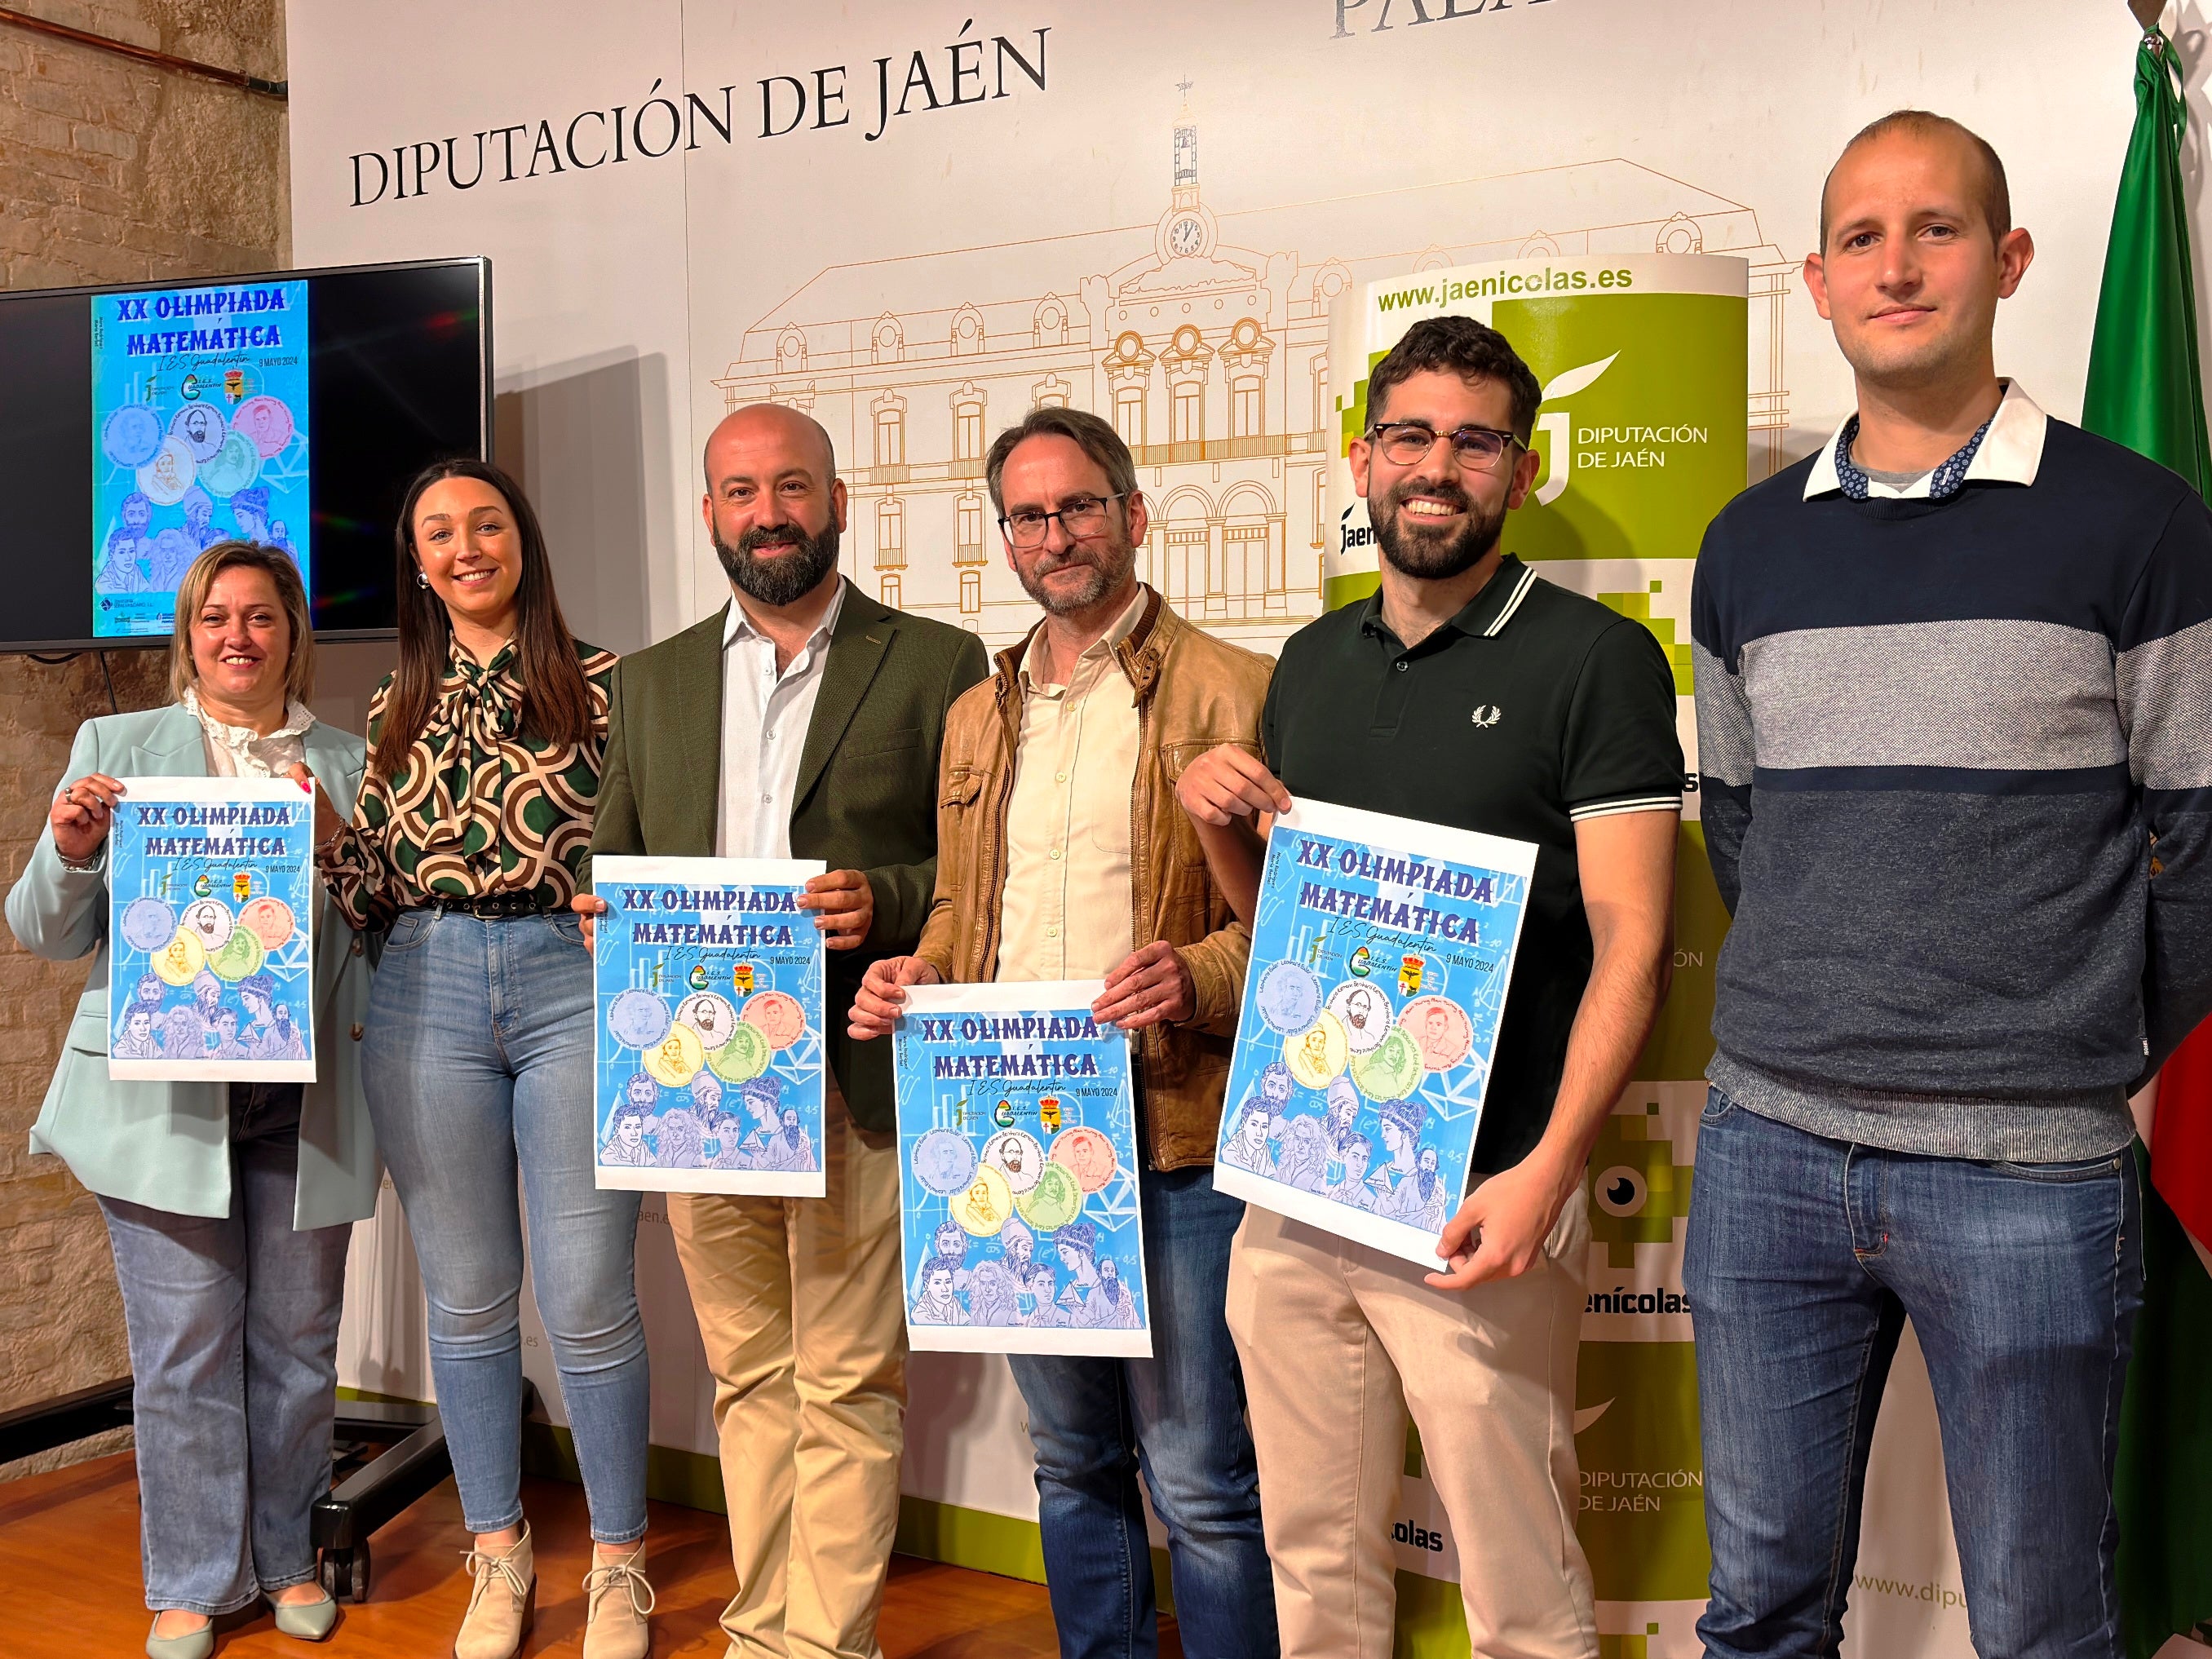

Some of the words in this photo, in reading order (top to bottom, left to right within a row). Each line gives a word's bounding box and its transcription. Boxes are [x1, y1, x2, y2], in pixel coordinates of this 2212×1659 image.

[348, 77, 736, 208] DIPUTACIÓN
[757, 66, 849, 139] DE
[865, 19, 1052, 142] JAÉN
[1378, 268, 1633, 311] www.jaenicolas.es
[117, 299, 148, 321] XX
[154, 289, 285, 319] OLIMPIADA
[126, 317, 283, 356] MATEMÁTICA
[259, 358, 263, 367] 9
[264, 357, 281, 367] MAYO
[282, 356, 298, 366] 2024
[1577, 423, 1708, 445] DIPUTACIÓN
[1577, 451, 1606, 469] DE
[1611, 448, 1665, 468] JAÉN
[137, 807, 166, 825] XX
[171, 807, 290, 825] OLIMPIADA
[145, 829, 285, 856] MATEMÁTICA
[1296, 839, 1334, 869] XX
[1338, 848, 1493, 904] OLIMPIADA
[622, 890, 654, 909] XX
[661, 890, 799, 912] OLIMPIADA
[1299, 881, 1480, 945] MATEMÁTICA
[632, 914, 794, 945] MATEMÁTICA
[770, 957, 774, 965] 9
[775, 957, 794, 965] MAYO
[794, 957, 811, 965] 2024
[1446, 954, 1451, 963] 9
[1452, 955, 1474, 968] MAYO
[1475, 959, 1495, 973] 2024
[922, 1020, 954, 1041] XX
[960, 1016, 1099, 1040] OLIMPIADA
[934, 1044, 1098, 1077] MATEMÁTICA
[1076, 1089, 1080, 1097] 9
[1082, 1088, 1100, 1097] MAYO
[1101, 1088, 1117, 1096] 2024
[1579, 1469, 1703, 1489] DIPUTACIÓN
[1608, 1493, 1661, 1511] JAÉN
[1855, 1574, 1967, 1609] www.dipu
